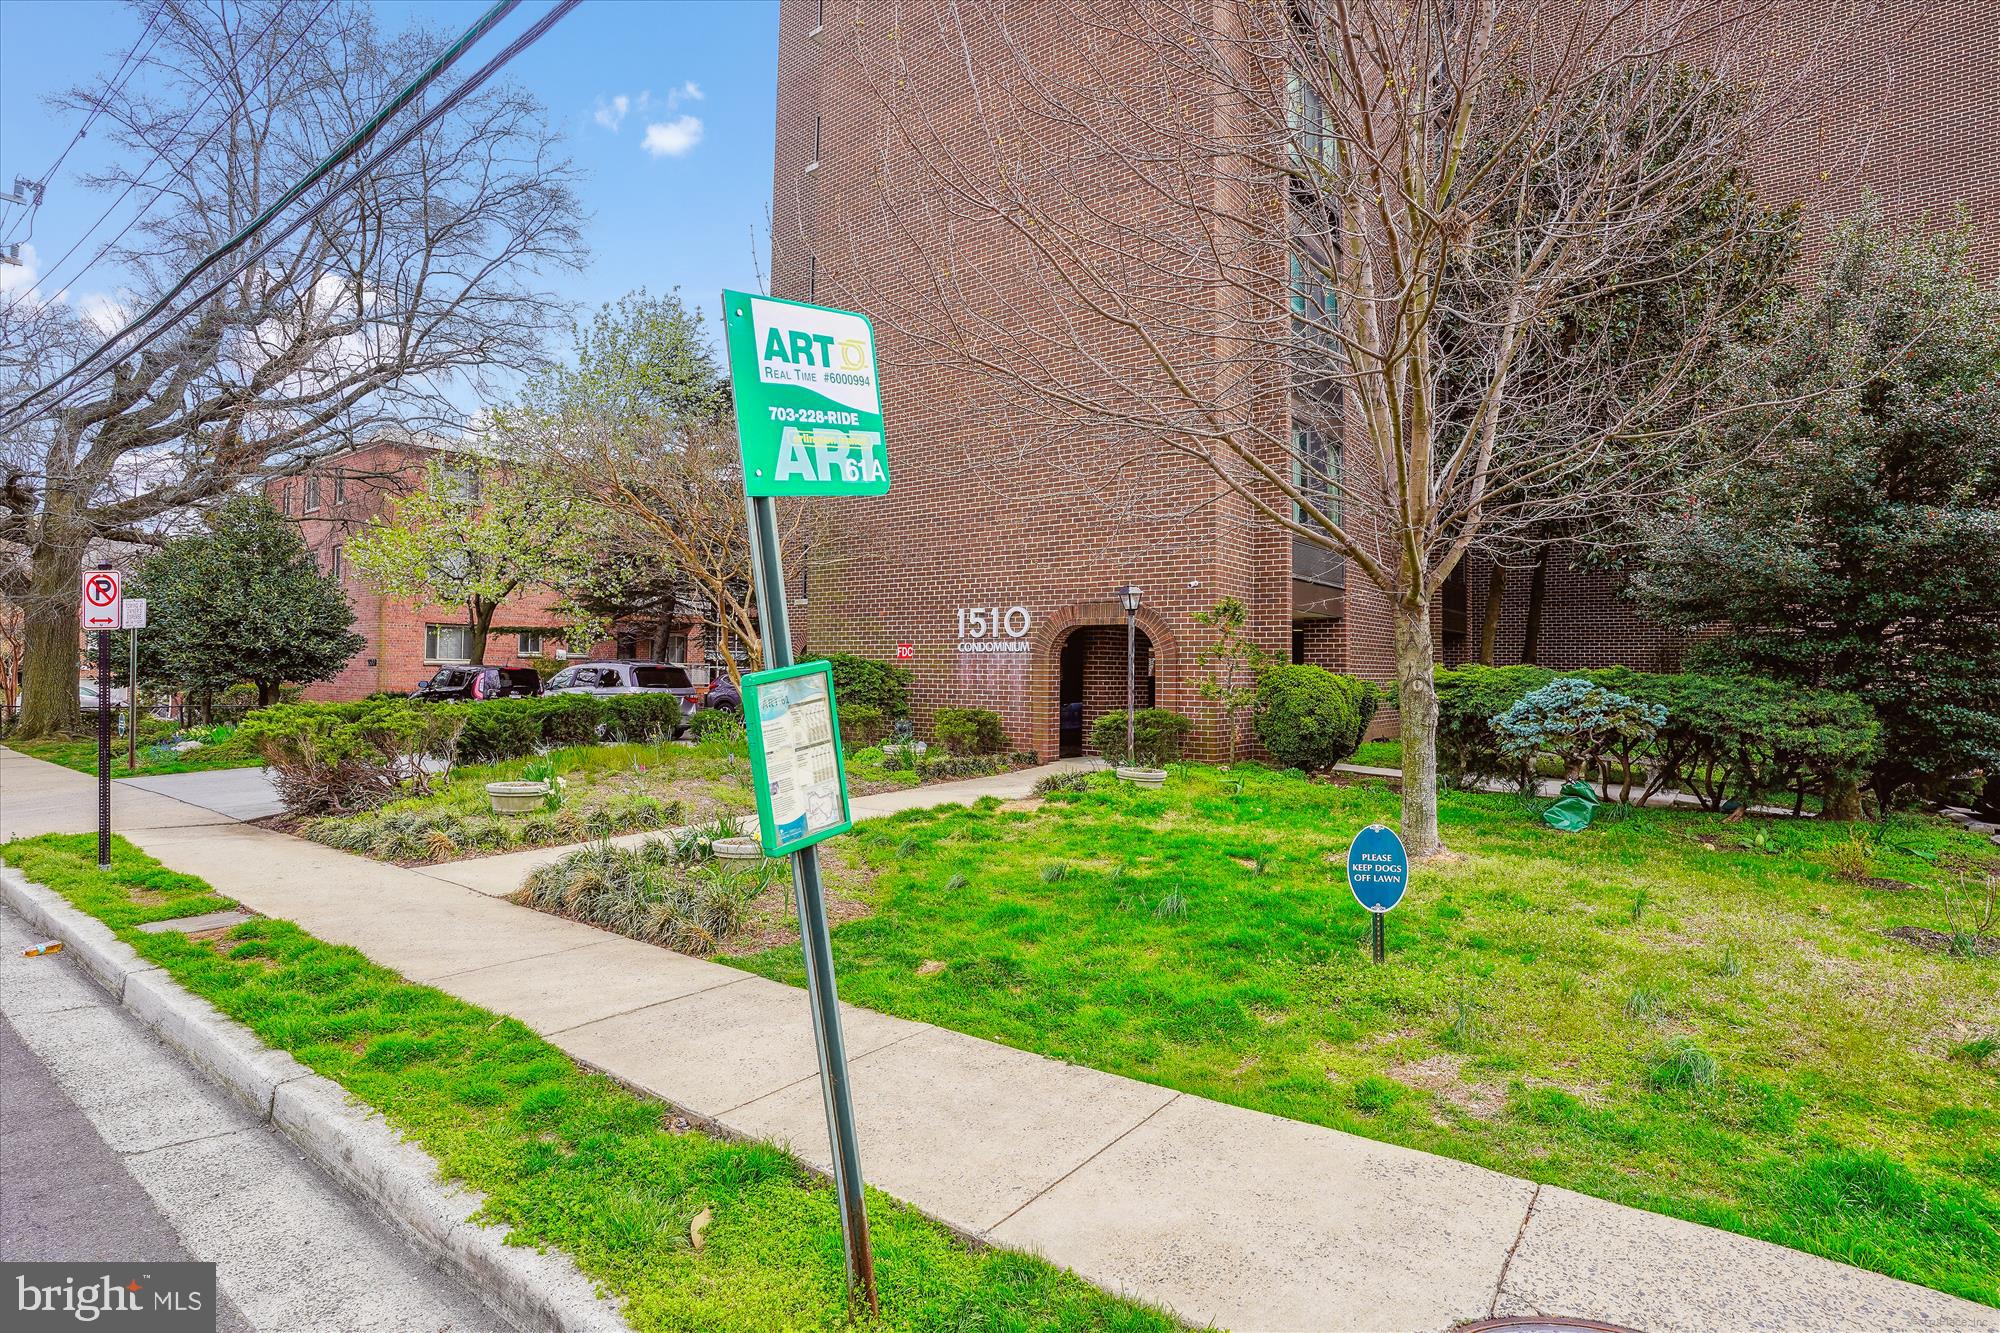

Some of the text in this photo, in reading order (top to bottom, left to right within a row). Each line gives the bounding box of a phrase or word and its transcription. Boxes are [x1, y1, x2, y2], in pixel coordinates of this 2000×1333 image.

[764, 327, 834, 369] ART
[824, 372, 870, 387] #6000994
[768, 406, 860, 426] 703-228-RIDE
[774, 426, 882, 482] ART
[845, 458, 887, 483] 61A
[957, 605, 1031, 639] 1510
[897, 646, 913, 657] FDC
[957, 641, 1030, 653] CONDOMINIUM
[1361, 853, 1392, 862] PLEASE
[1352, 863, 1402, 873] KEEP DOGS
[1353, 873, 1401, 883] OFF LAWN
